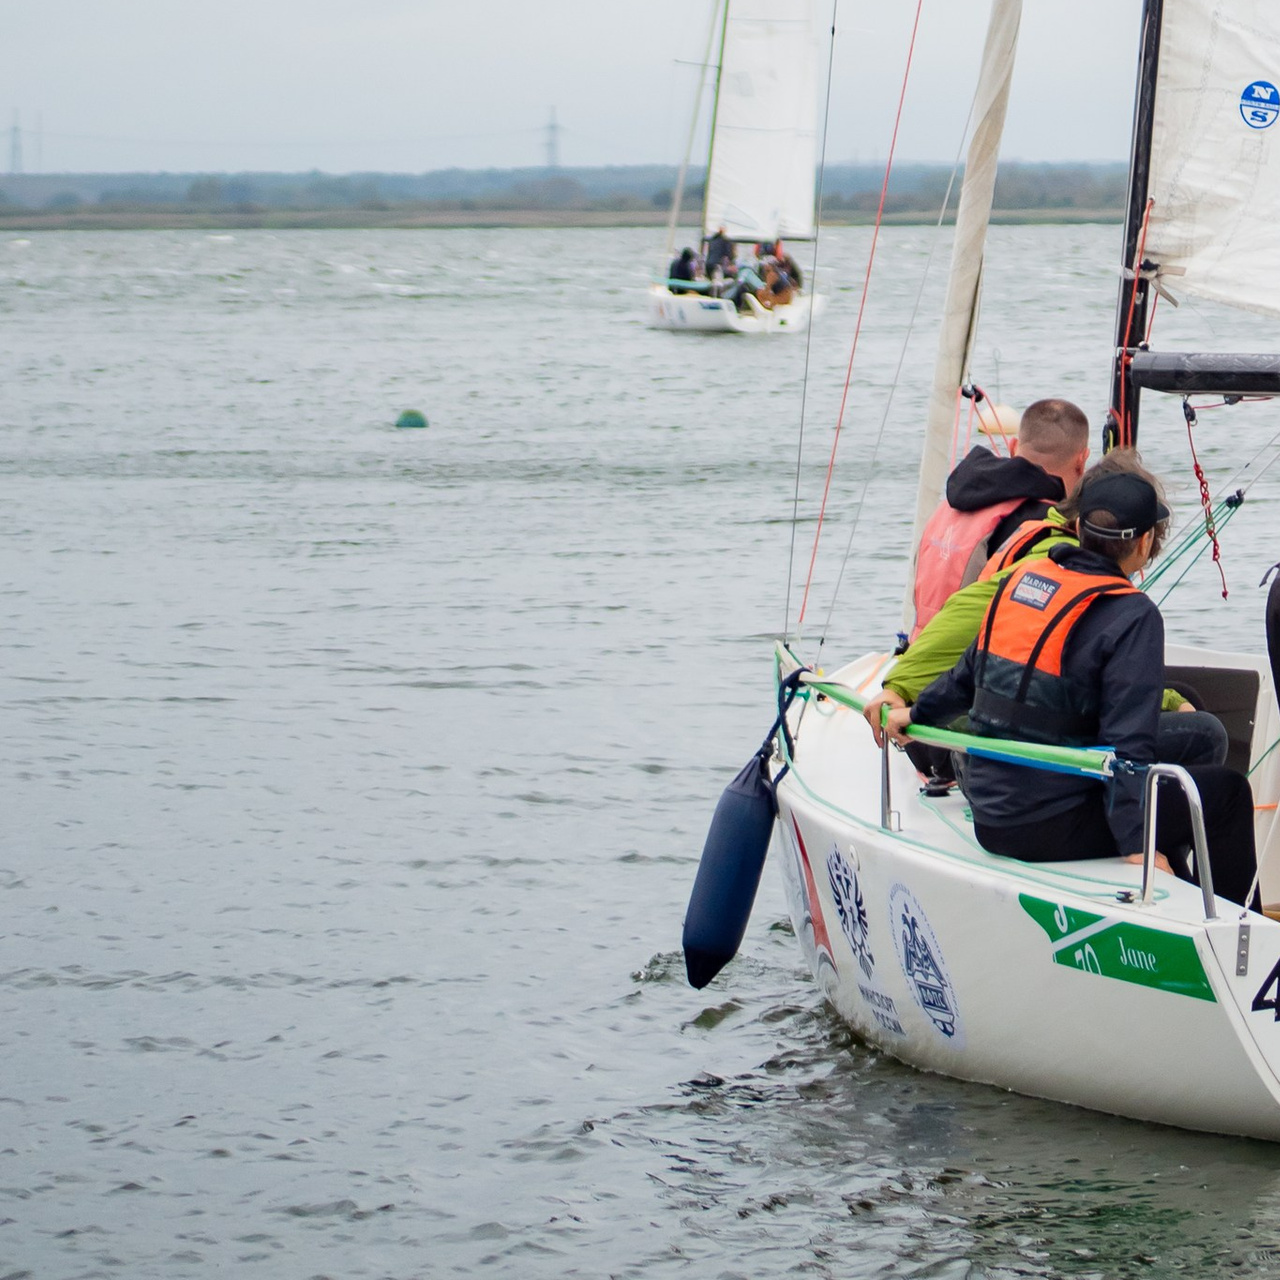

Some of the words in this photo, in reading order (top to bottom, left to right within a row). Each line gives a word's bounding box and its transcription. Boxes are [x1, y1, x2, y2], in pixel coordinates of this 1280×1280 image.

[1251, 85, 1274, 100] N
[1250, 110, 1269, 123] S
[1020, 574, 1056, 594] MARINE
[1117, 936, 1158, 974] Jane
